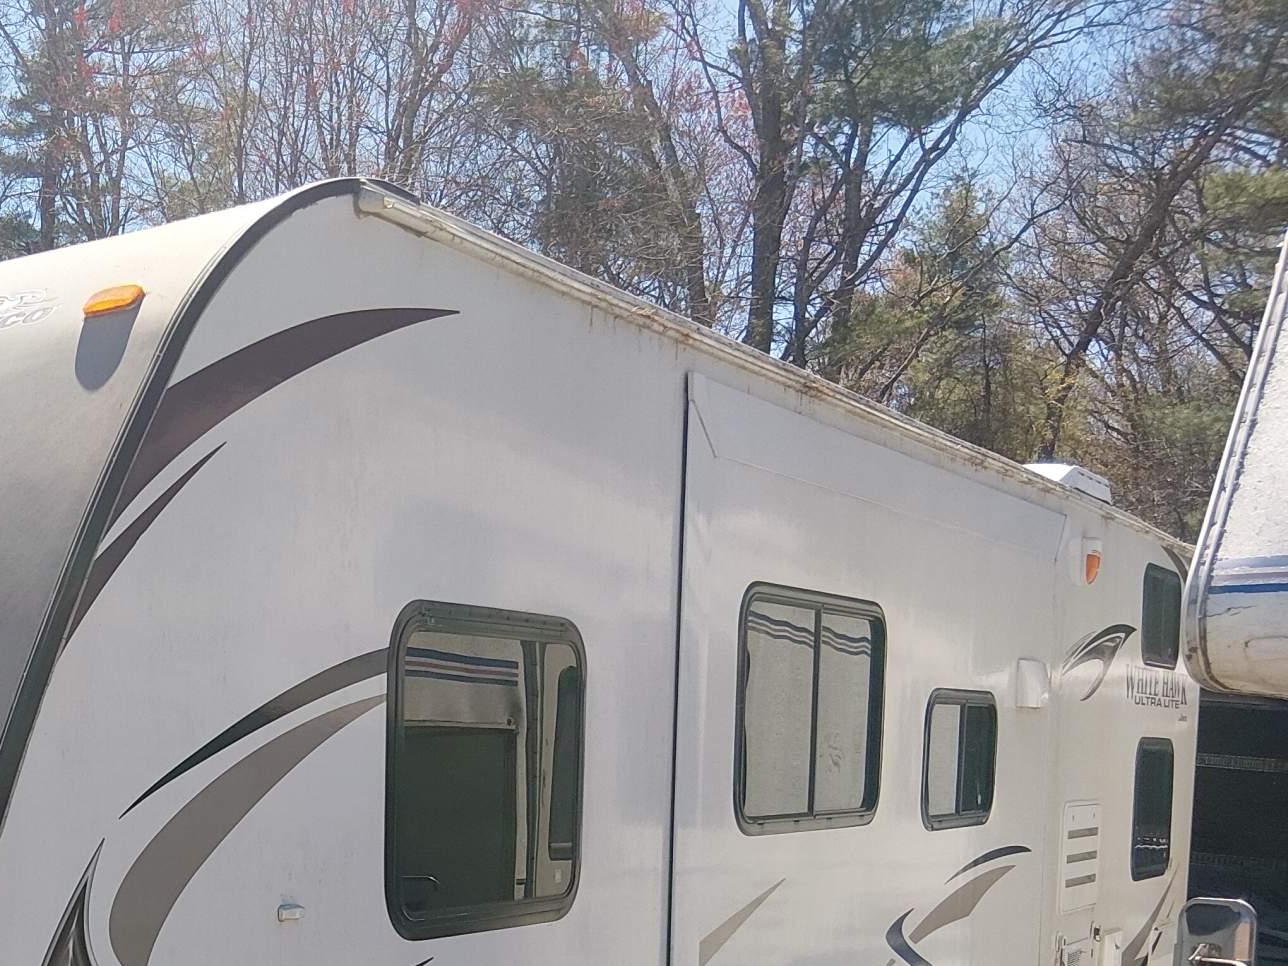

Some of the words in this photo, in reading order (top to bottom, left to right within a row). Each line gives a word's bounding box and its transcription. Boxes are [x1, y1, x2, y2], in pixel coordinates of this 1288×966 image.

[1126, 664, 1160, 701] WHITE
[1161, 671, 1188, 705] HAWK
[1134, 695, 1162, 708] ULTRA
[1163, 699, 1181, 709] LITE
